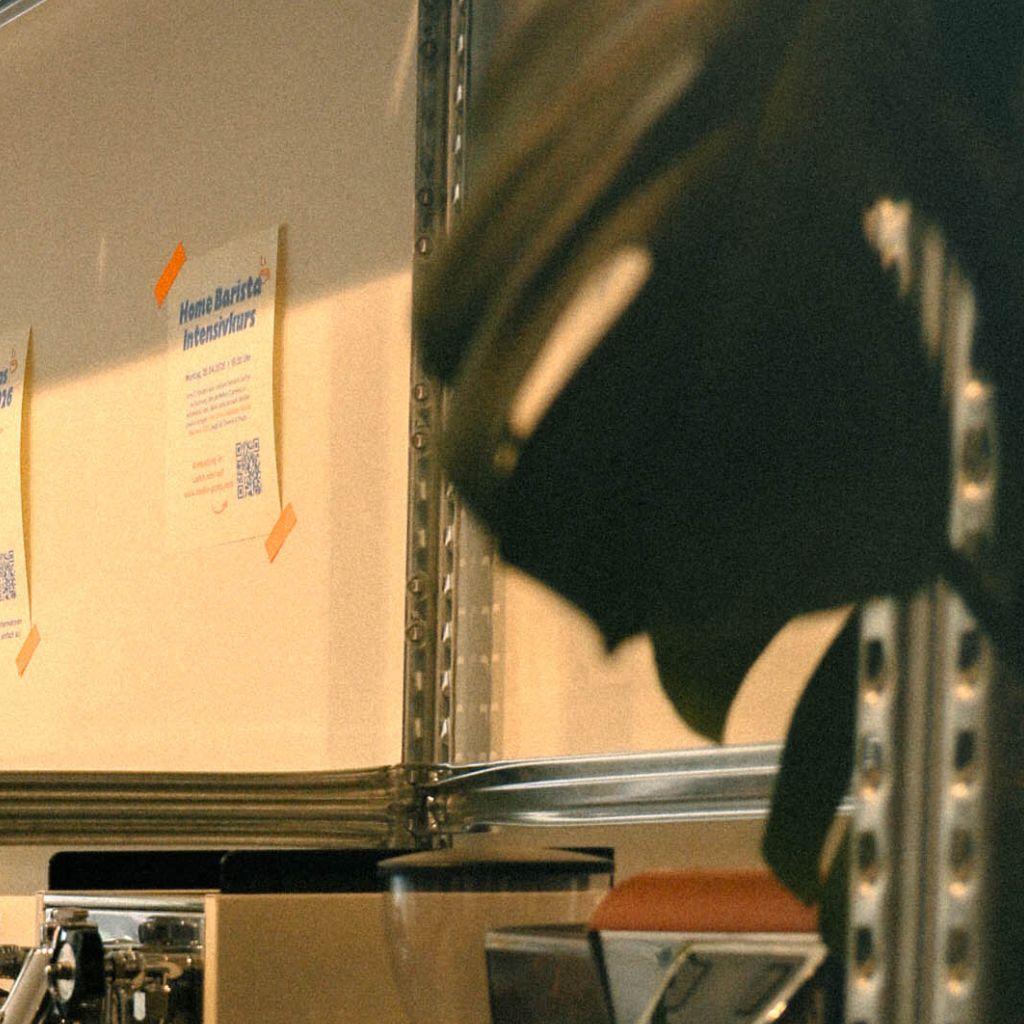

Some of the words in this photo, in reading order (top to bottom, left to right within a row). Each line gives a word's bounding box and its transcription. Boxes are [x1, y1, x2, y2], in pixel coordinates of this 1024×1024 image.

[179, 296, 213, 325] Home
[214, 275, 263, 311] Barista
[183, 308, 256, 351] Intensivkurs
